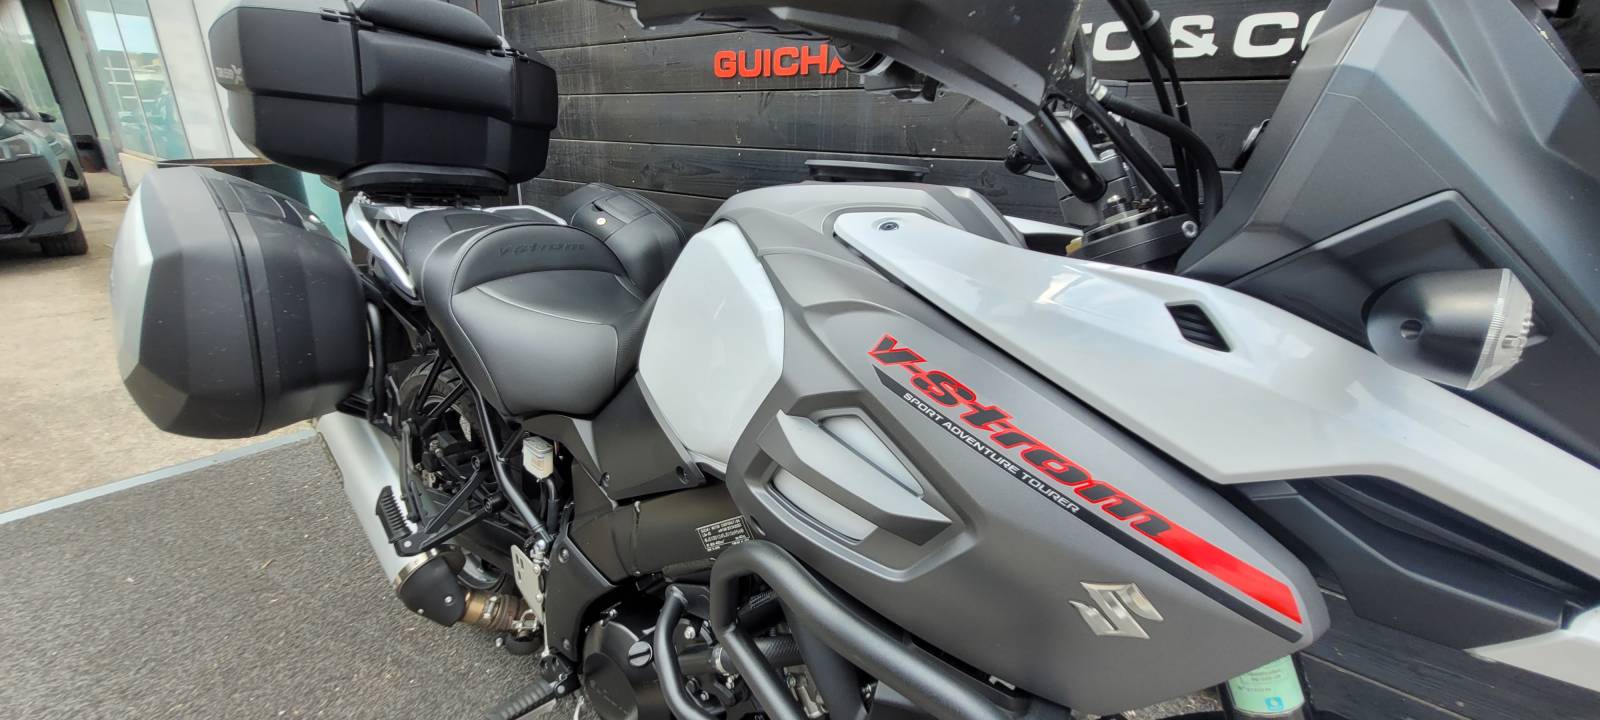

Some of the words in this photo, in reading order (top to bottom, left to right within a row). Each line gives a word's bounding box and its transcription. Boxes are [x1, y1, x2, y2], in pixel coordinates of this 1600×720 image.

[1170, 14, 1219, 59] &
[902, 391, 945, 421] SPORT
[943, 420, 1021, 475] ADVENTURE
[1021, 471, 1081, 514] TOURER
